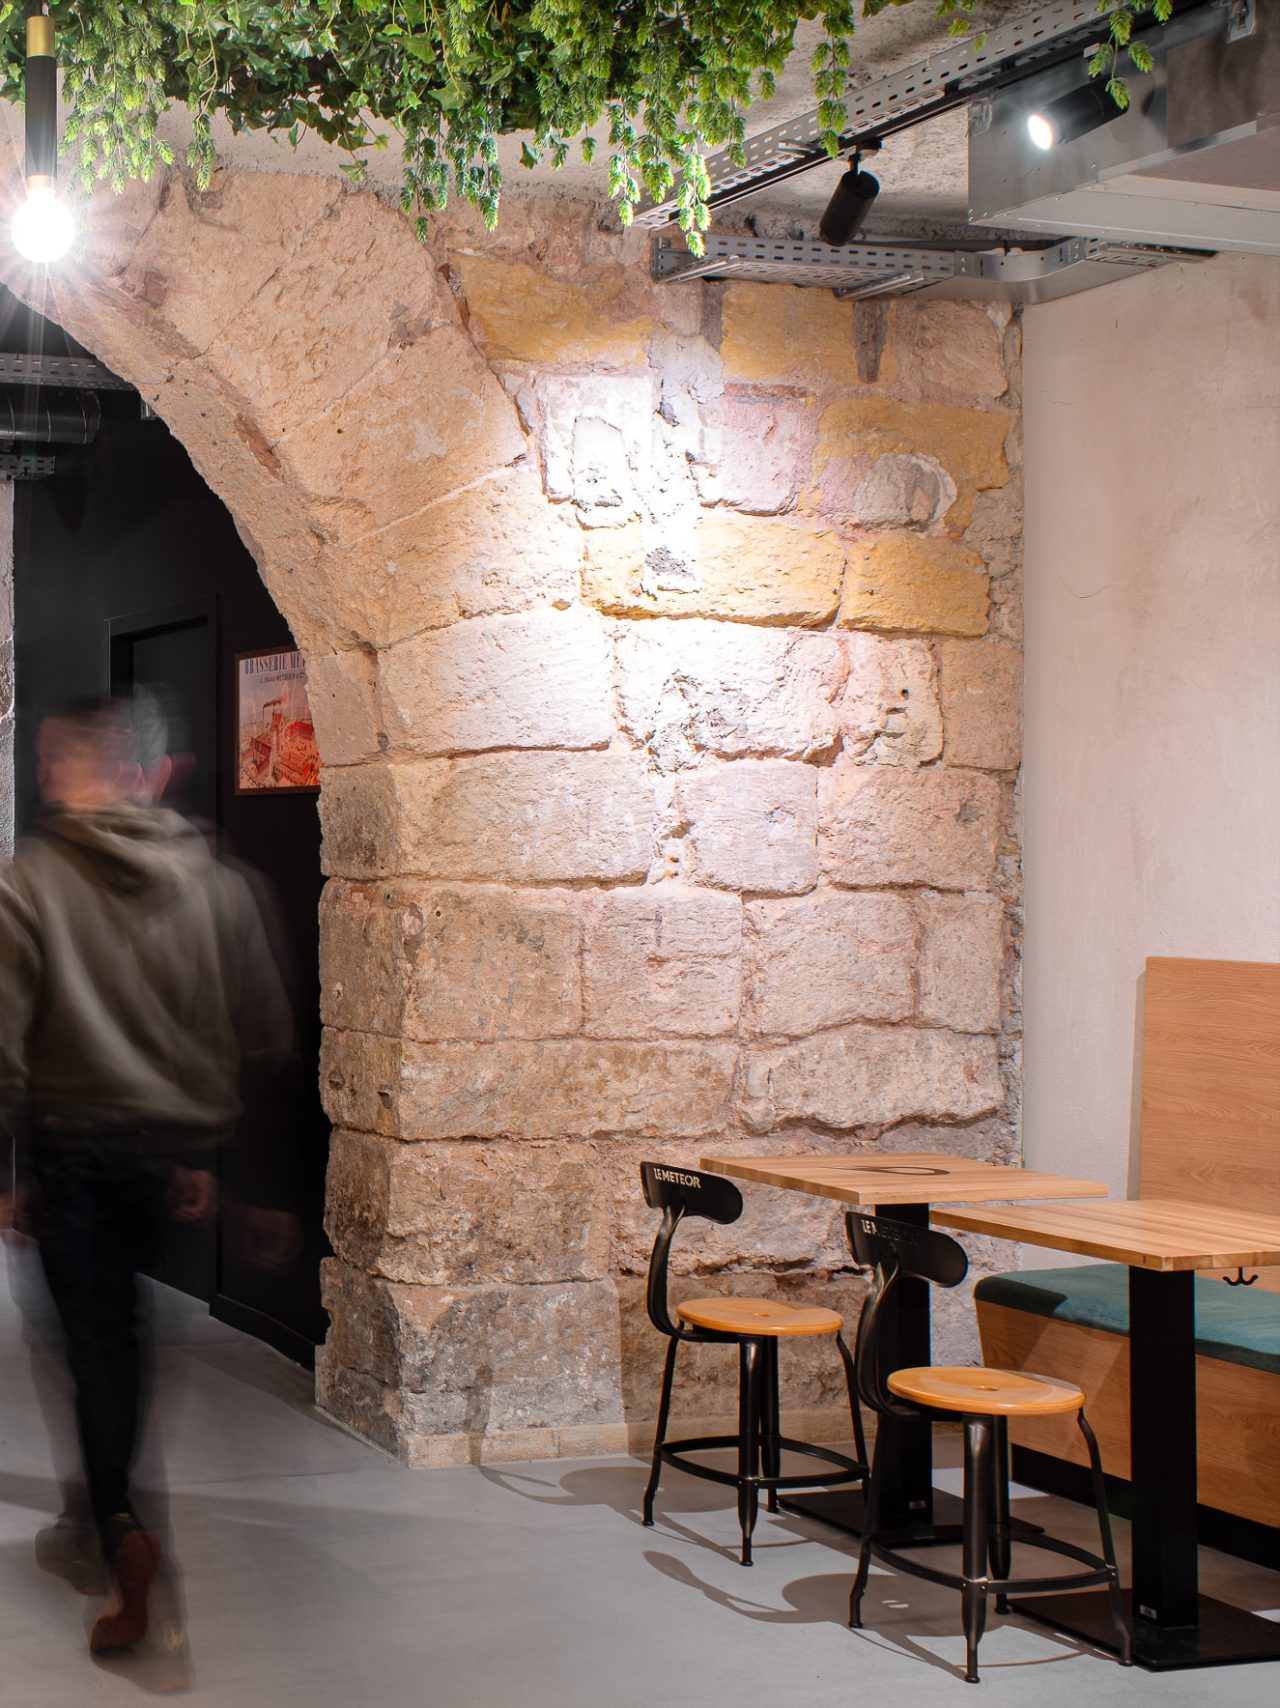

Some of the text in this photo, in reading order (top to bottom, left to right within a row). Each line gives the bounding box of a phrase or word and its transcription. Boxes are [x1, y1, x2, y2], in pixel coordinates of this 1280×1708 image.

[244, 654, 288, 675] BRASSERIE
[653, 1167, 702, 1189] LE METEOR
[861, 1219, 871, 1234] LE
